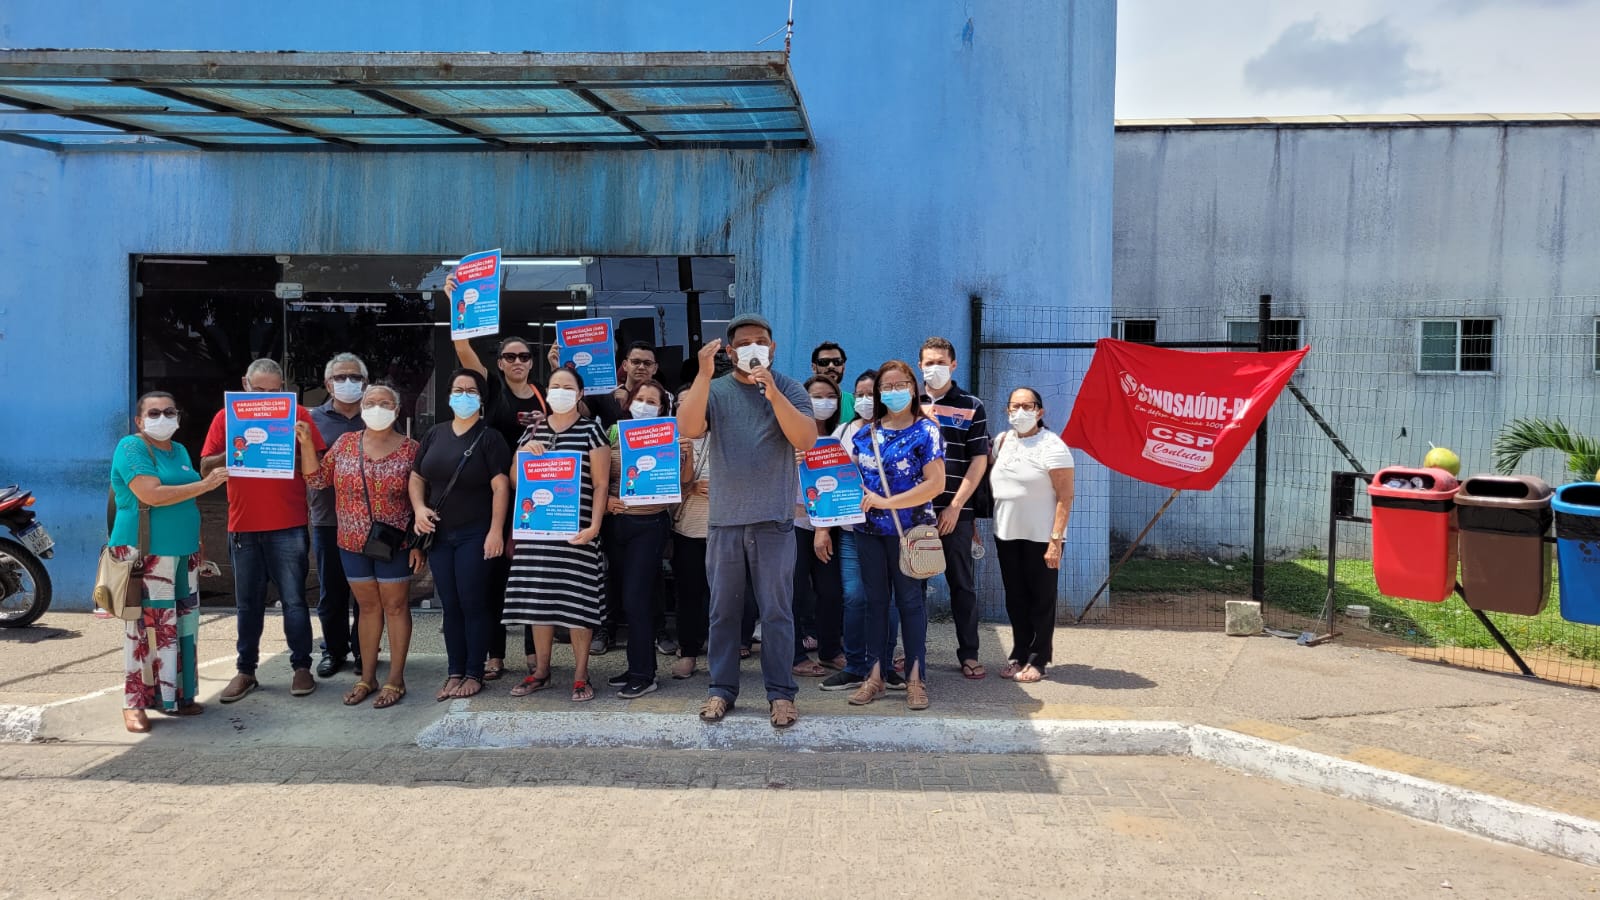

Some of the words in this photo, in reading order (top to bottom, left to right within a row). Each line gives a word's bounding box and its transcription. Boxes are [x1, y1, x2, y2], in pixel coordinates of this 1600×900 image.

[629, 426, 658, 436] PARALISAÇÃO
[636, 433, 664, 441] ADVERTÊNCIA
[1152, 427, 1214, 447] CSP
[1152, 444, 1208, 462] Conlutas
